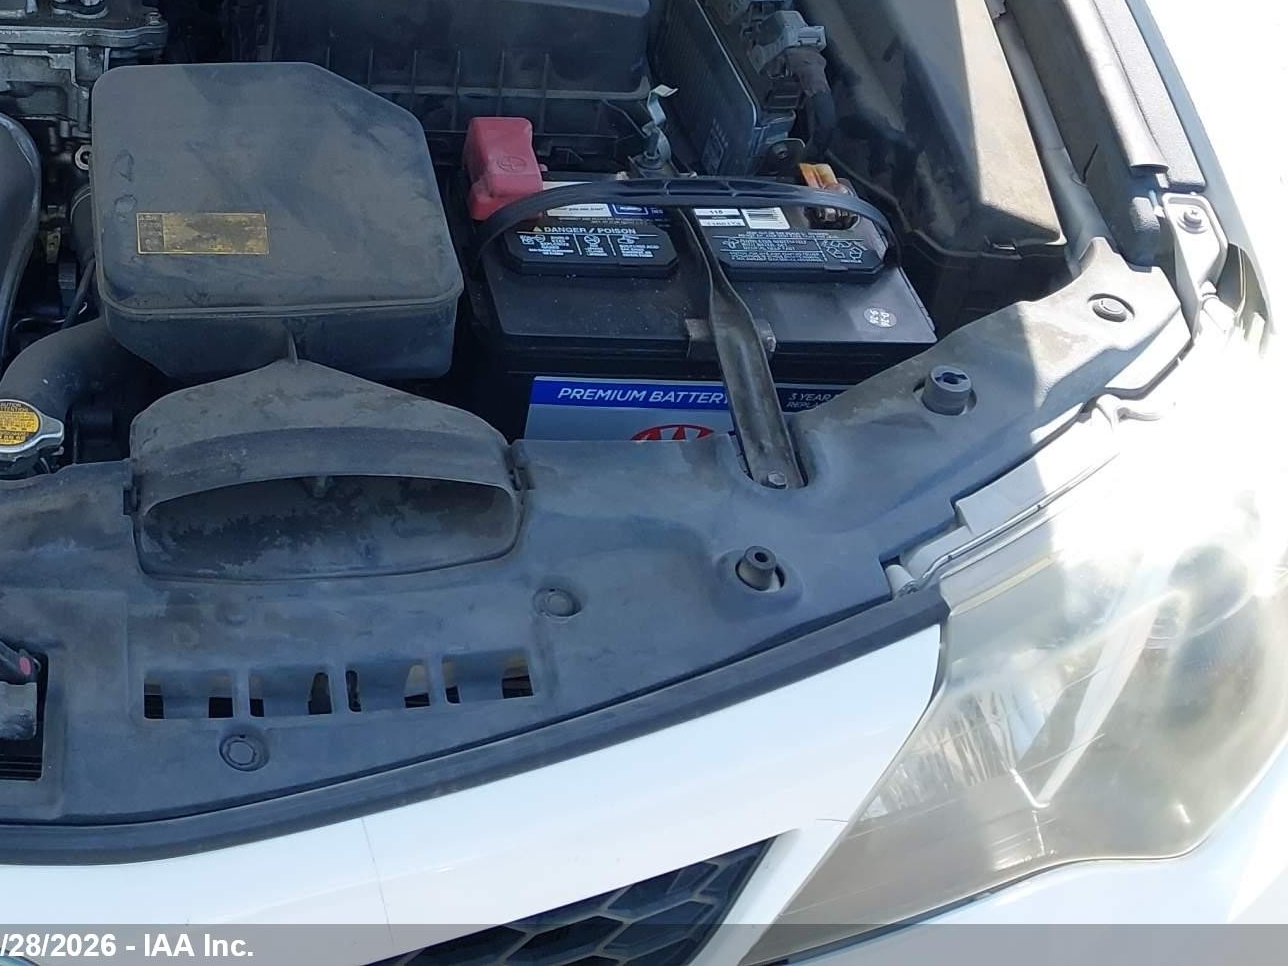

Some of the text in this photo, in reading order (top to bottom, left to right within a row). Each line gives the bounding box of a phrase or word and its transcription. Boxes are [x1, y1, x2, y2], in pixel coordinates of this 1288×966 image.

[598, 227, 636, 235] POISON
[557, 387, 646, 402] PREMIUM
[788, 393, 832, 402] 3 YEAR
